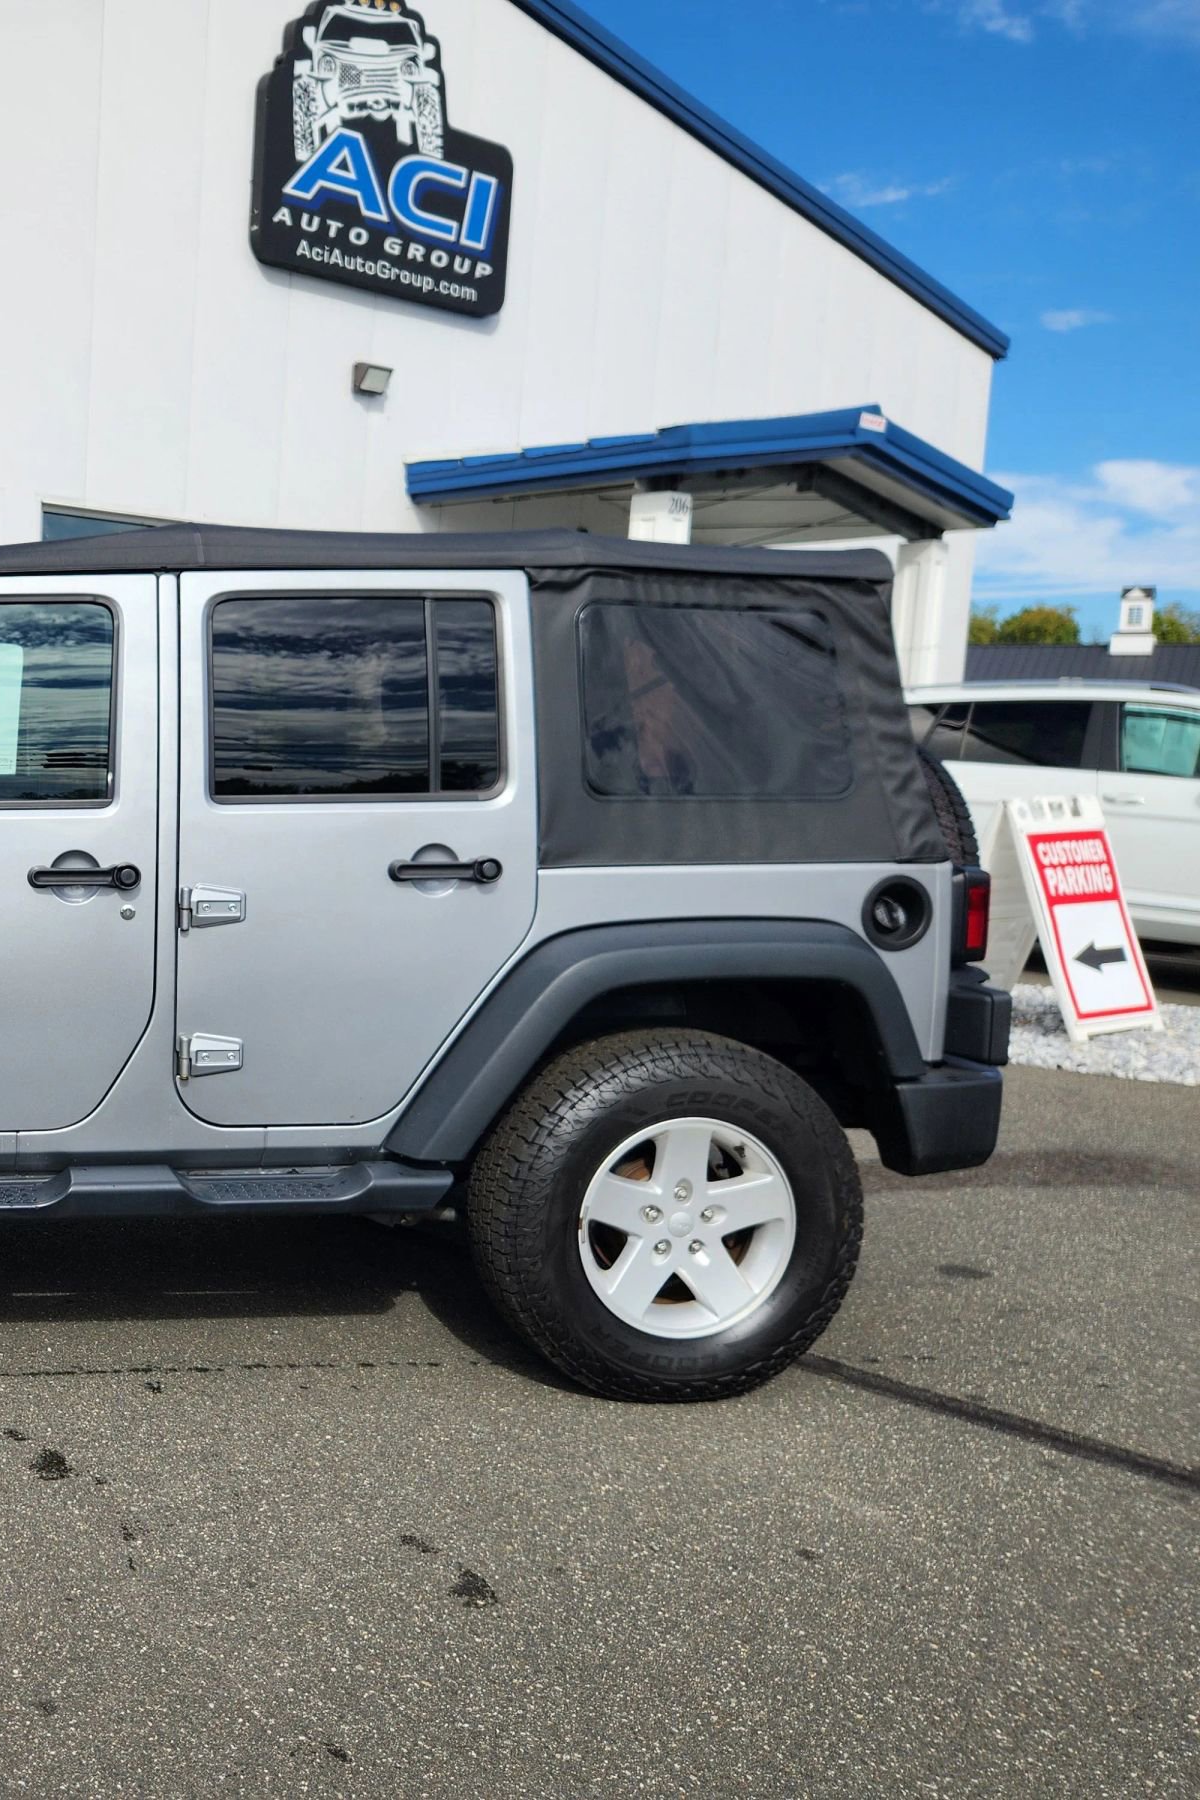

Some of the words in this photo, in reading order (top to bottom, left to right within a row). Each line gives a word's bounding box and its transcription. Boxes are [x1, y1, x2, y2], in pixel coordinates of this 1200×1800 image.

[281, 126, 500, 252] ACI
[272, 206, 370, 246] AUTO
[382, 235, 494, 279] GROUP
[295, 239, 479, 302] AciAutoGroup.com
[1036, 838, 1106, 866] CUSTOMER
[1046, 863, 1114, 897] PARKING
